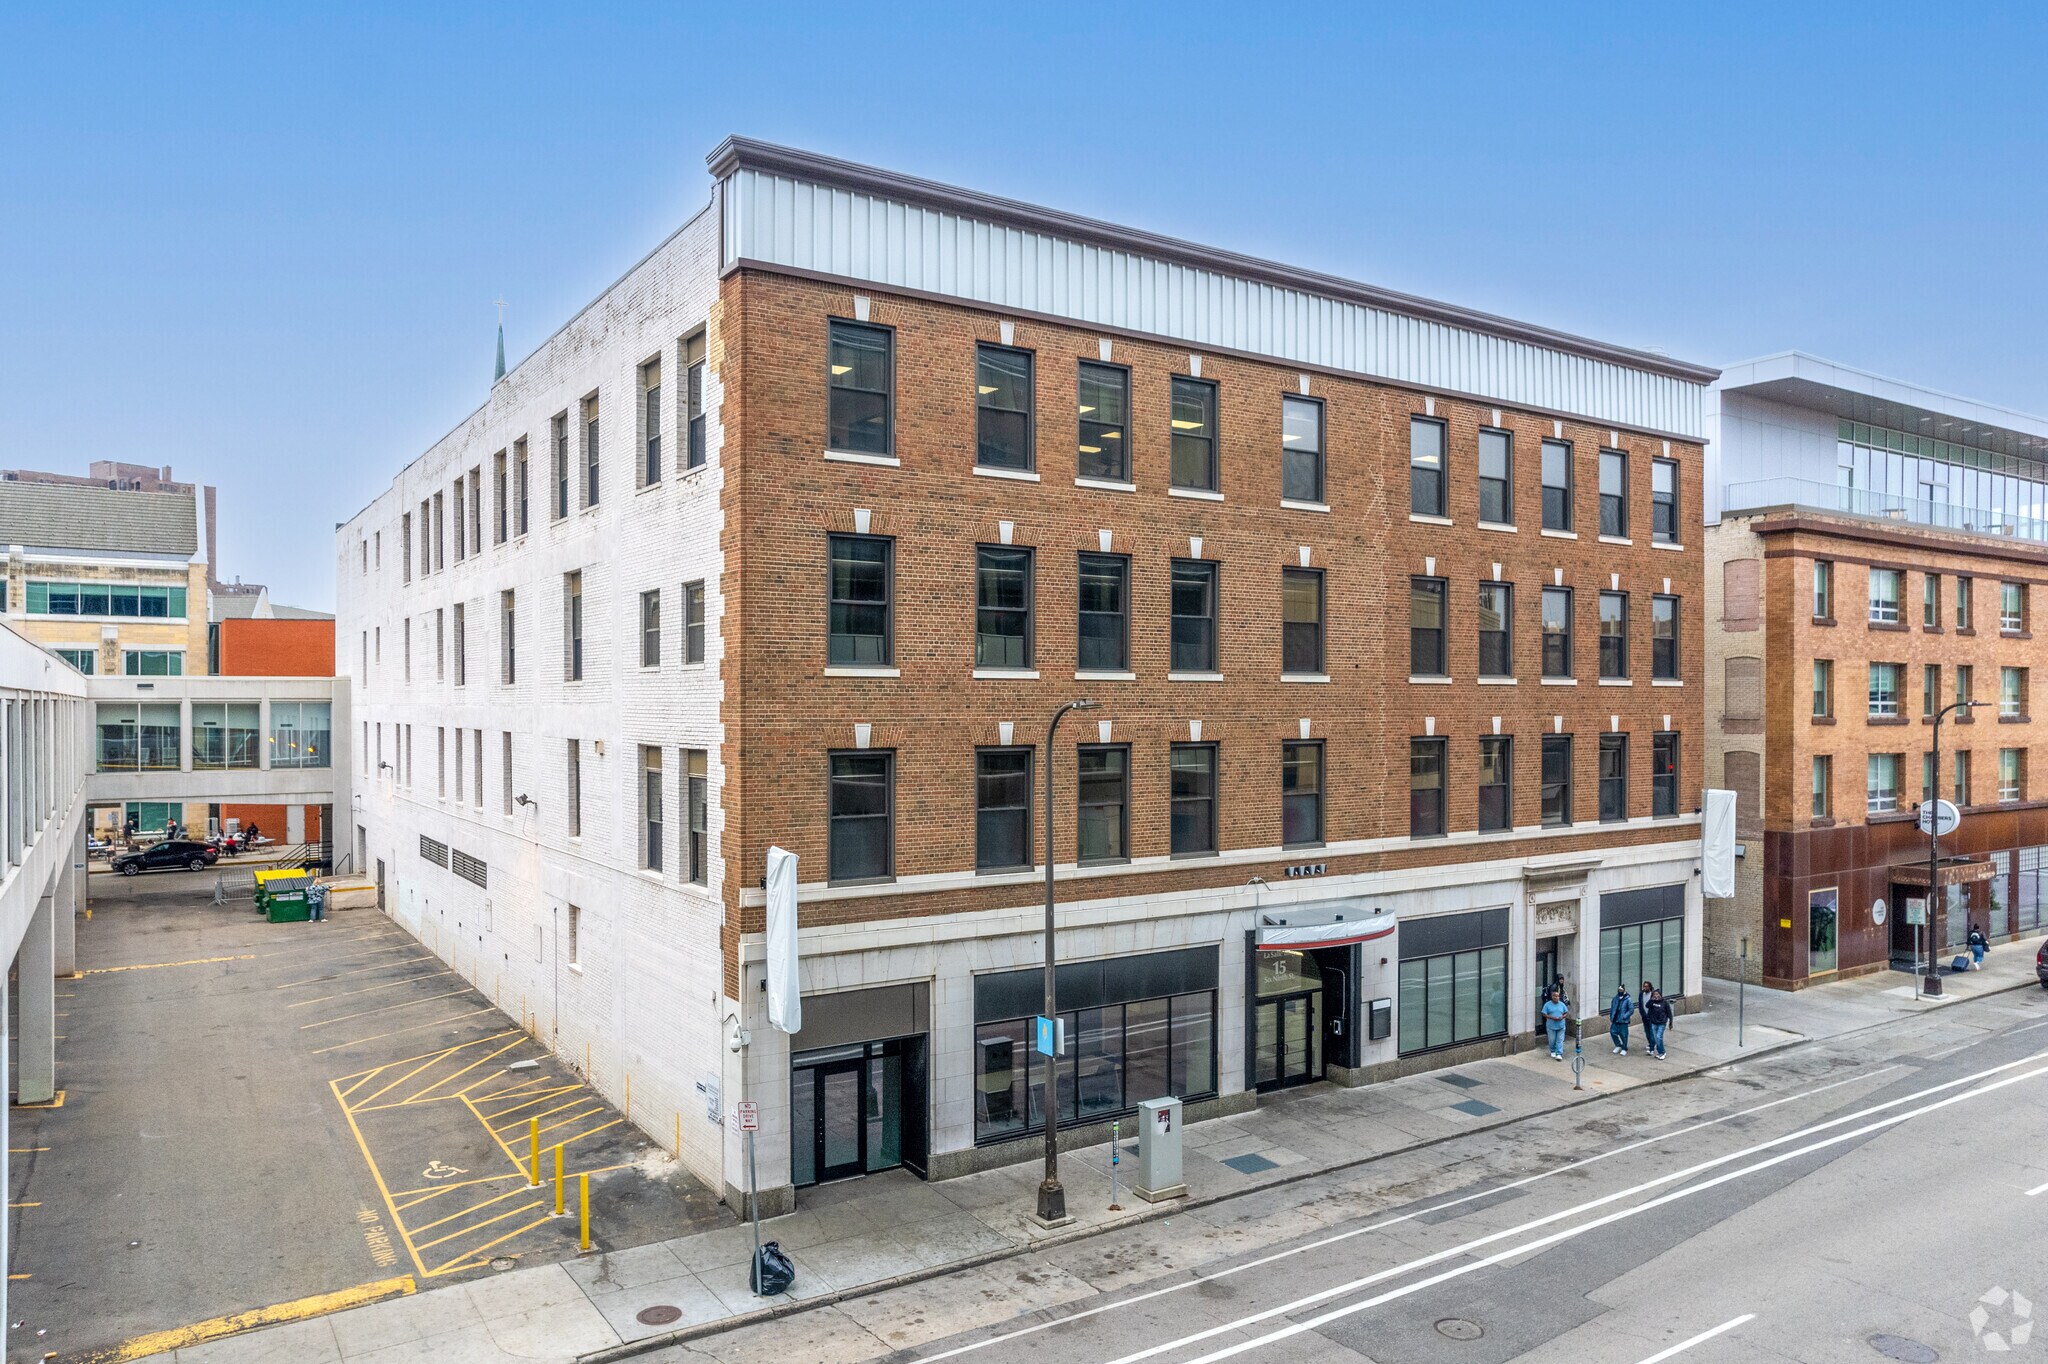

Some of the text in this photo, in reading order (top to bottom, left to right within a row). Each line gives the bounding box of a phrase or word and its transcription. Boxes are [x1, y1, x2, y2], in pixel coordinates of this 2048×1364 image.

[1272, 960, 1286, 974] 15
[356, 1209, 398, 1267] NO PARKING
